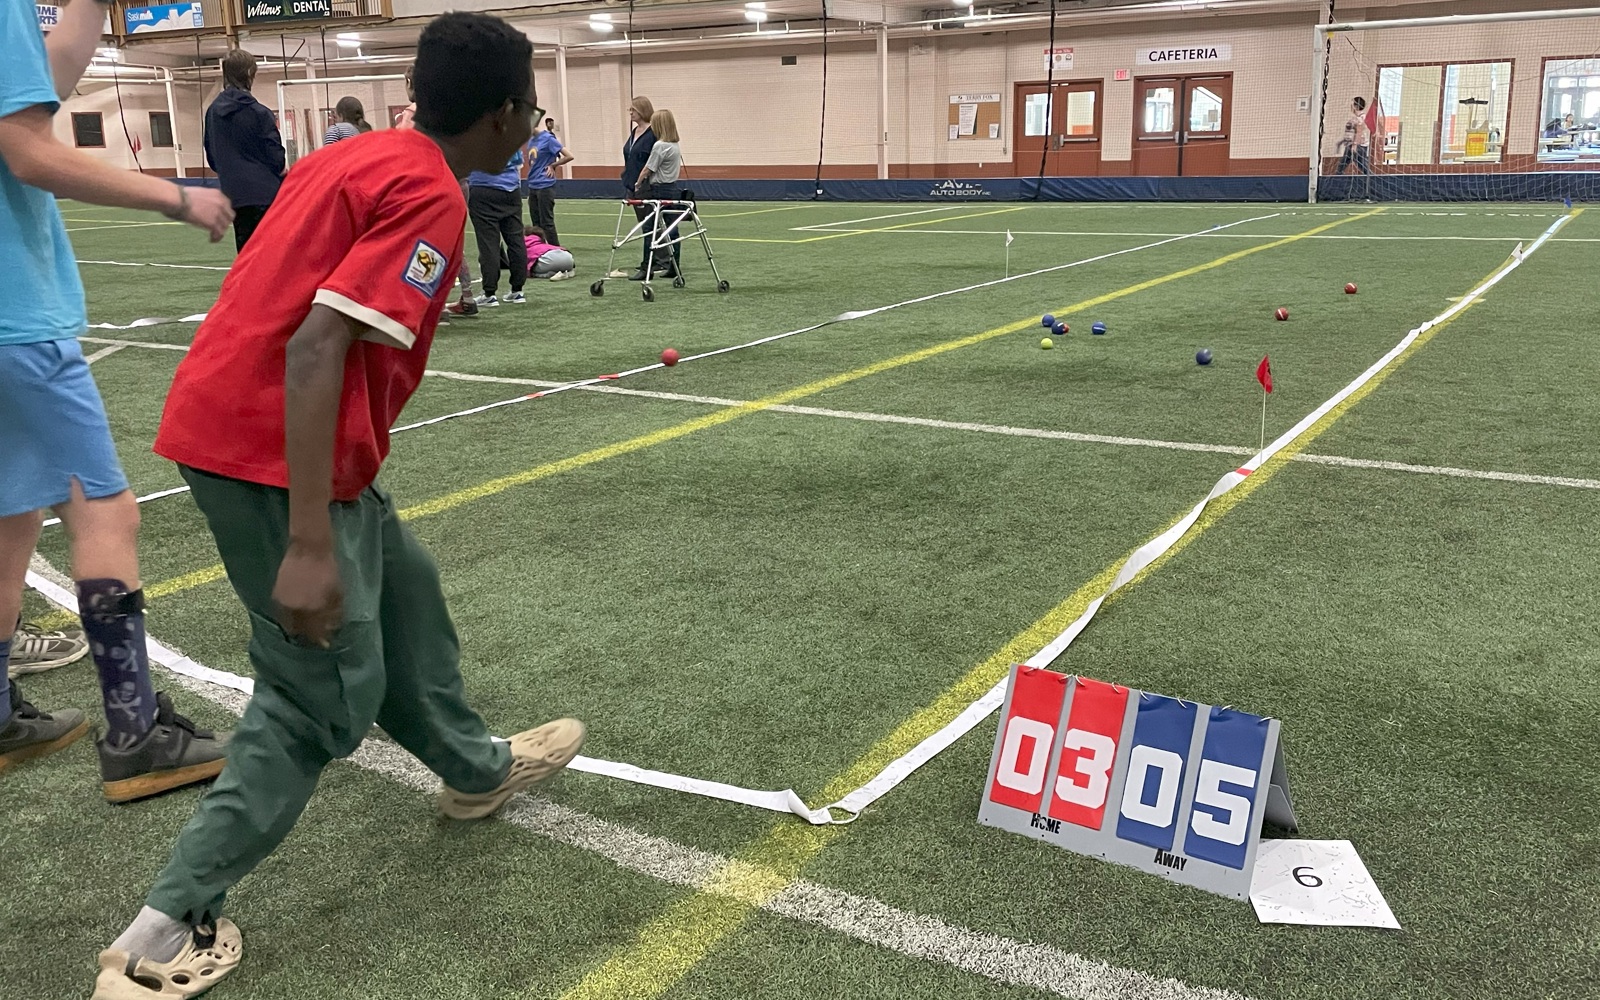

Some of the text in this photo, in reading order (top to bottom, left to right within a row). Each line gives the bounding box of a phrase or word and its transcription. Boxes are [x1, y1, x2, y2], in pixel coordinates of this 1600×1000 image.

[36, 6, 57, 15] IME
[247, 0, 330, 18] Willows DENTAL
[1148, 48, 1218, 61] CAFETERIA
[1116, 69, 1127, 79] EXIT
[1030, 813, 1061, 834] HOME
[1153, 848, 1188, 871] AWAY
[1292, 866, 1323, 888] 6
